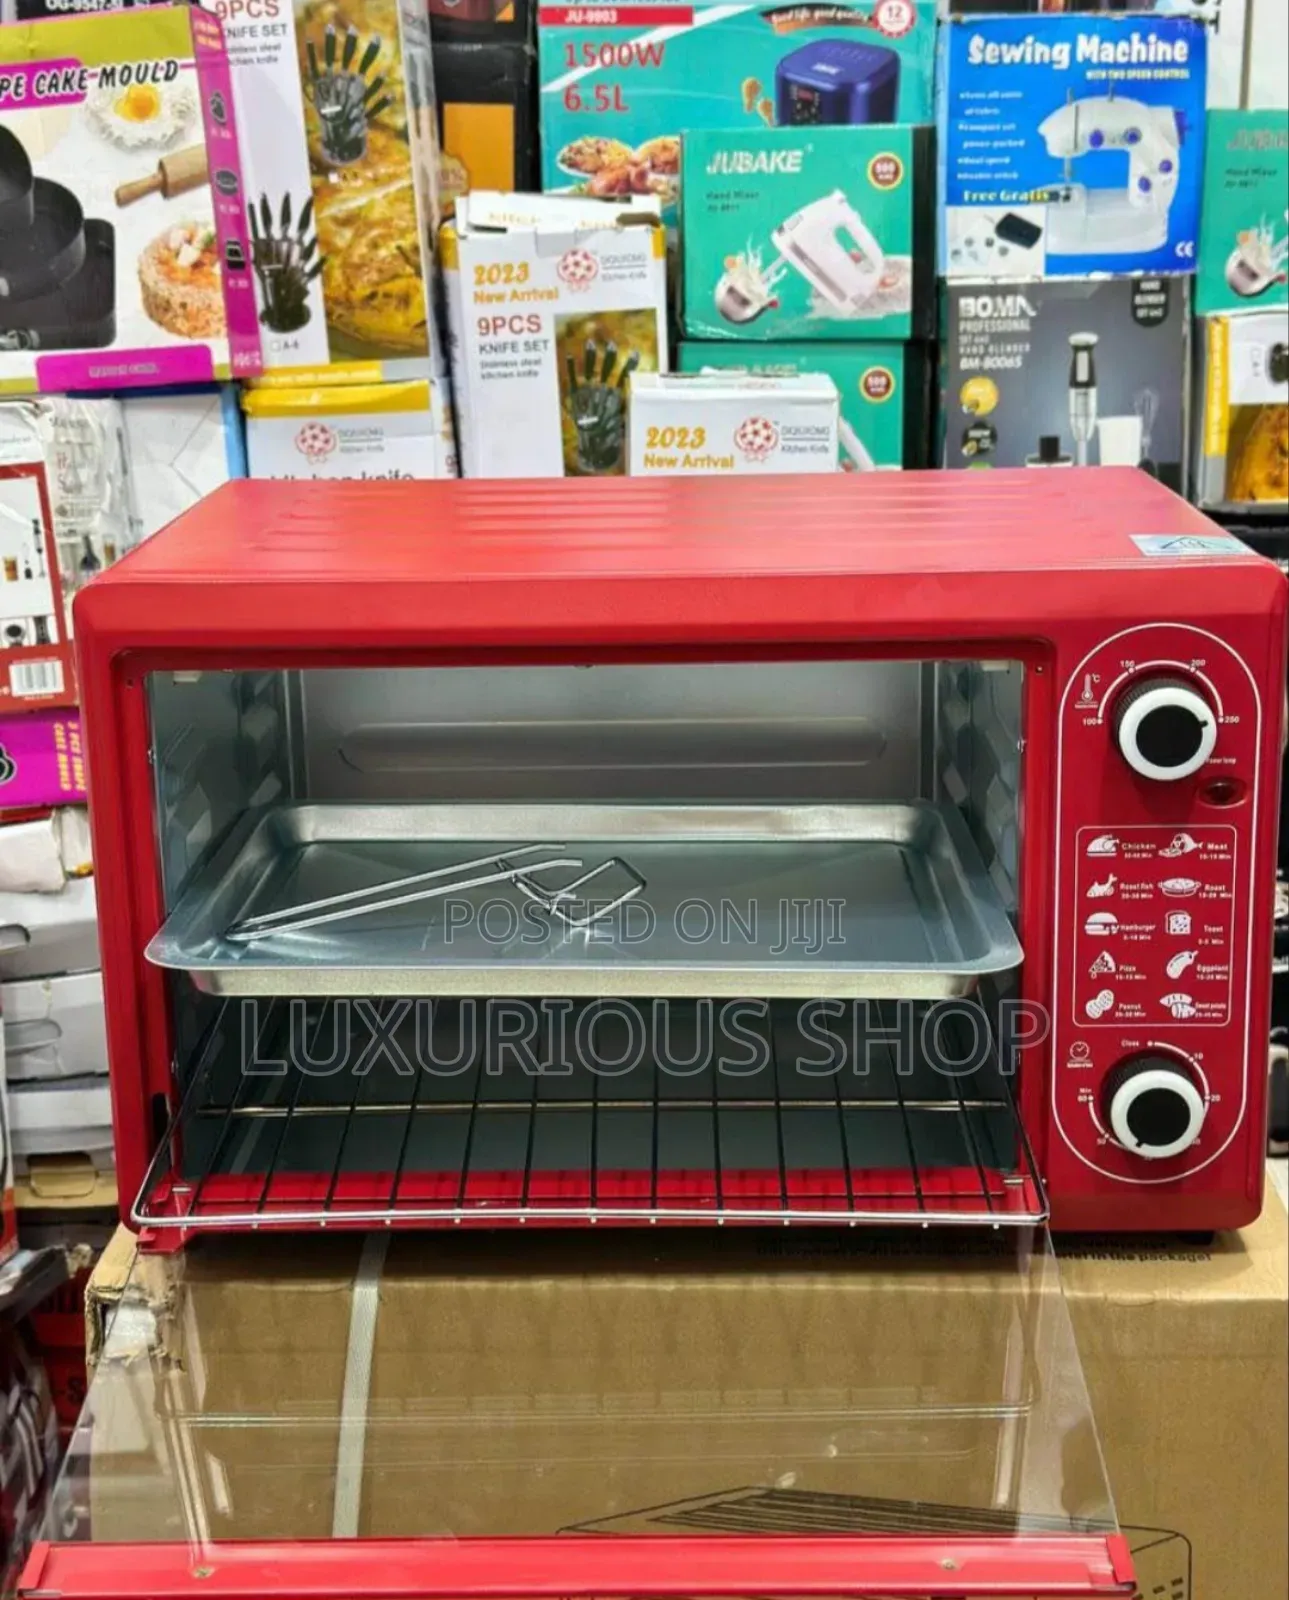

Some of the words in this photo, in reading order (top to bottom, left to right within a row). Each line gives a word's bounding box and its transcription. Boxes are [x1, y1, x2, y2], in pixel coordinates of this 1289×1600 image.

[887, 5, 904, 19] 12
[226, 24, 259, 38] NIFE
[262, 23, 288, 37] SET
[563, 43, 665, 69] 1500W
[967, 34, 1071, 70] Sewing
[1076, 32, 1189, 64] Machine
[35, 69, 88, 96] CAKE
[98, 60, 179, 88] MOULD
[563, 84, 629, 112] 6.5L
[706, 149, 804, 175] JUBAKE
[963, 190, 997, 202] Free
[1000, 189, 1049, 202] Gratis
[474, 262, 530, 286] 2023
[474, 291, 506, 305] New
[510, 287, 559, 302] Arrival
[477, 314, 541, 336] 9PCS
[479, 341, 519, 354] KNIFE
[523, 339, 549, 352] SET
[646, 427, 706, 449] 2023
[643, 454, 676, 468] New
[681, 453, 735, 469] Arrival
[1120, 660, 1136, 668] 150
[1191, 659, 1206, 667] 200
[1082, 717, 1097, 726] 100
[1224, 715, 1240, 724] 250
[1121, 842, 1156, 851] Chicken
[1206, 842, 1228, 851] Meat
[1204, 883, 1226, 892] Roast
[1120, 924, 1156, 932] Hamburger
[1203, 925, 1224, 933] Toast
[1196, 964, 1229, 973] Eggplant
[1194, 1052, 1204, 1060] 10
[1210, 1094, 1221, 1102] 20
